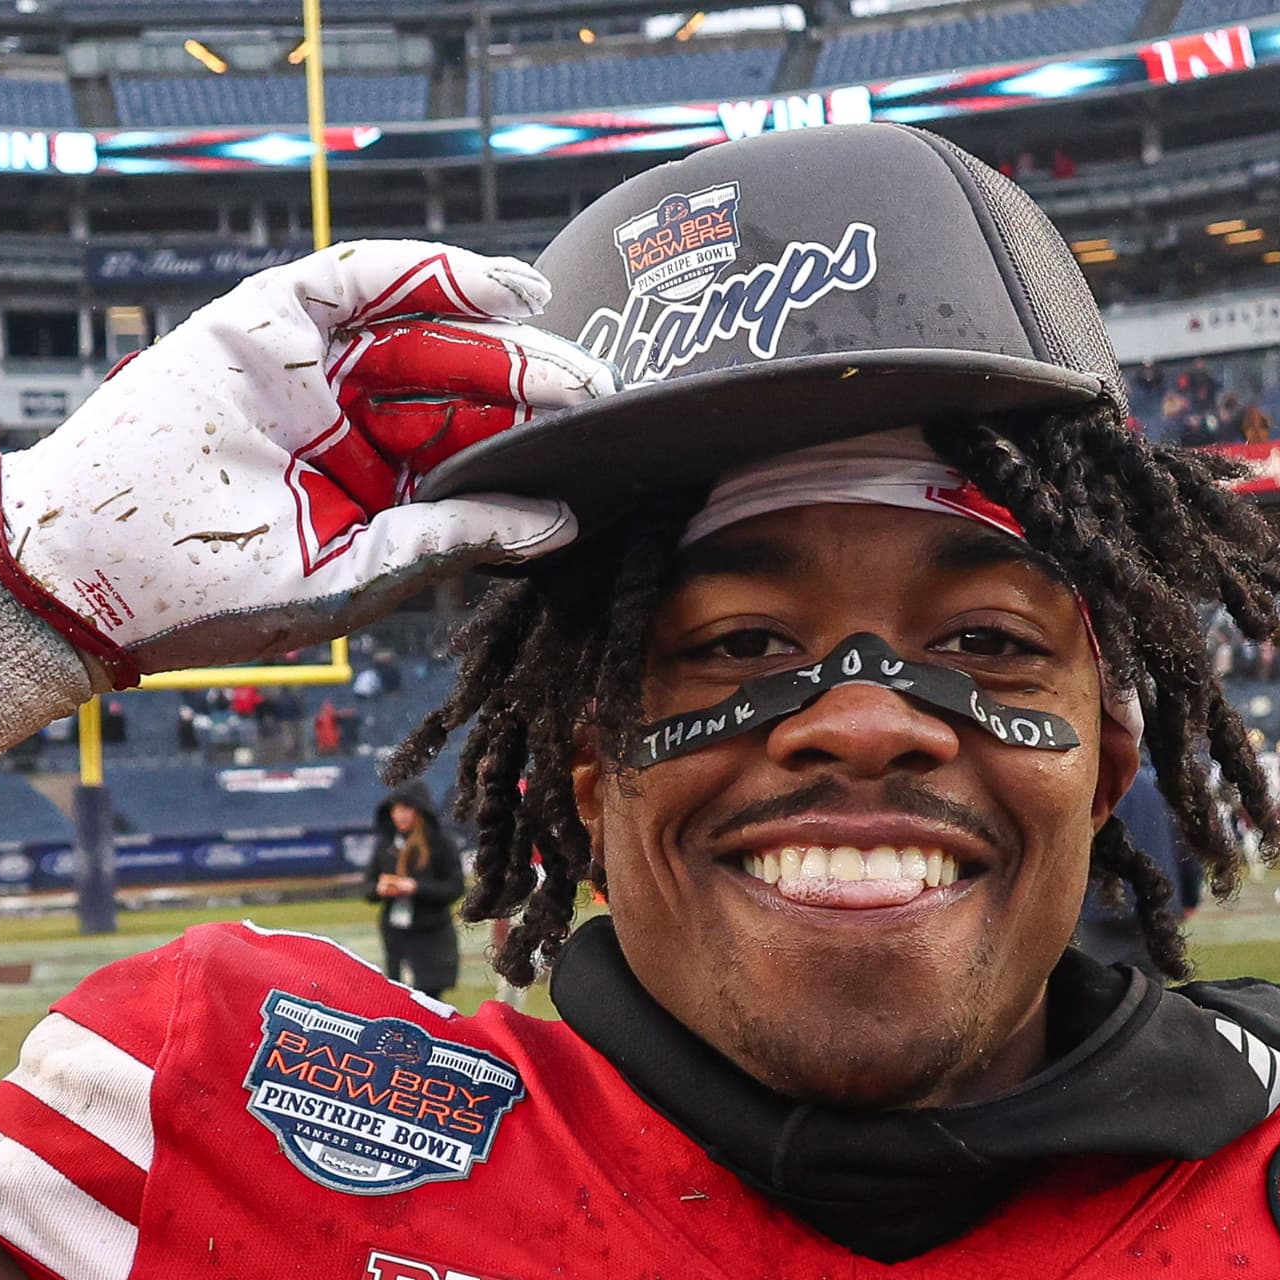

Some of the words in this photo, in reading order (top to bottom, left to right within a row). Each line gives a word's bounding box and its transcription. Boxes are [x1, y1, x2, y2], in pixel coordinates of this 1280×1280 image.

[628, 229, 673, 259] BAD
[680, 208, 730, 237] BOY
[630, 221, 734, 273] MOWERS
[637, 256, 693, 292] PINSTRIPE
[697, 246, 733, 265] BOWL
[643, 702, 756, 759] THANK
[796, 648, 905, 684] YOU
[969, 690, 1056, 747] GOD!
[266, 1050, 485, 1135] MOWERS
[276, 1029, 376, 1078] BAD
[390, 1068, 491, 1109] BOY
[262, 1086, 386, 1137] PINSTRIPE
[392, 1123, 463, 1166] BOWL
[295, 1122, 349, 1148] YANKEE
[354, 1141, 418, 1168] STADIUM
